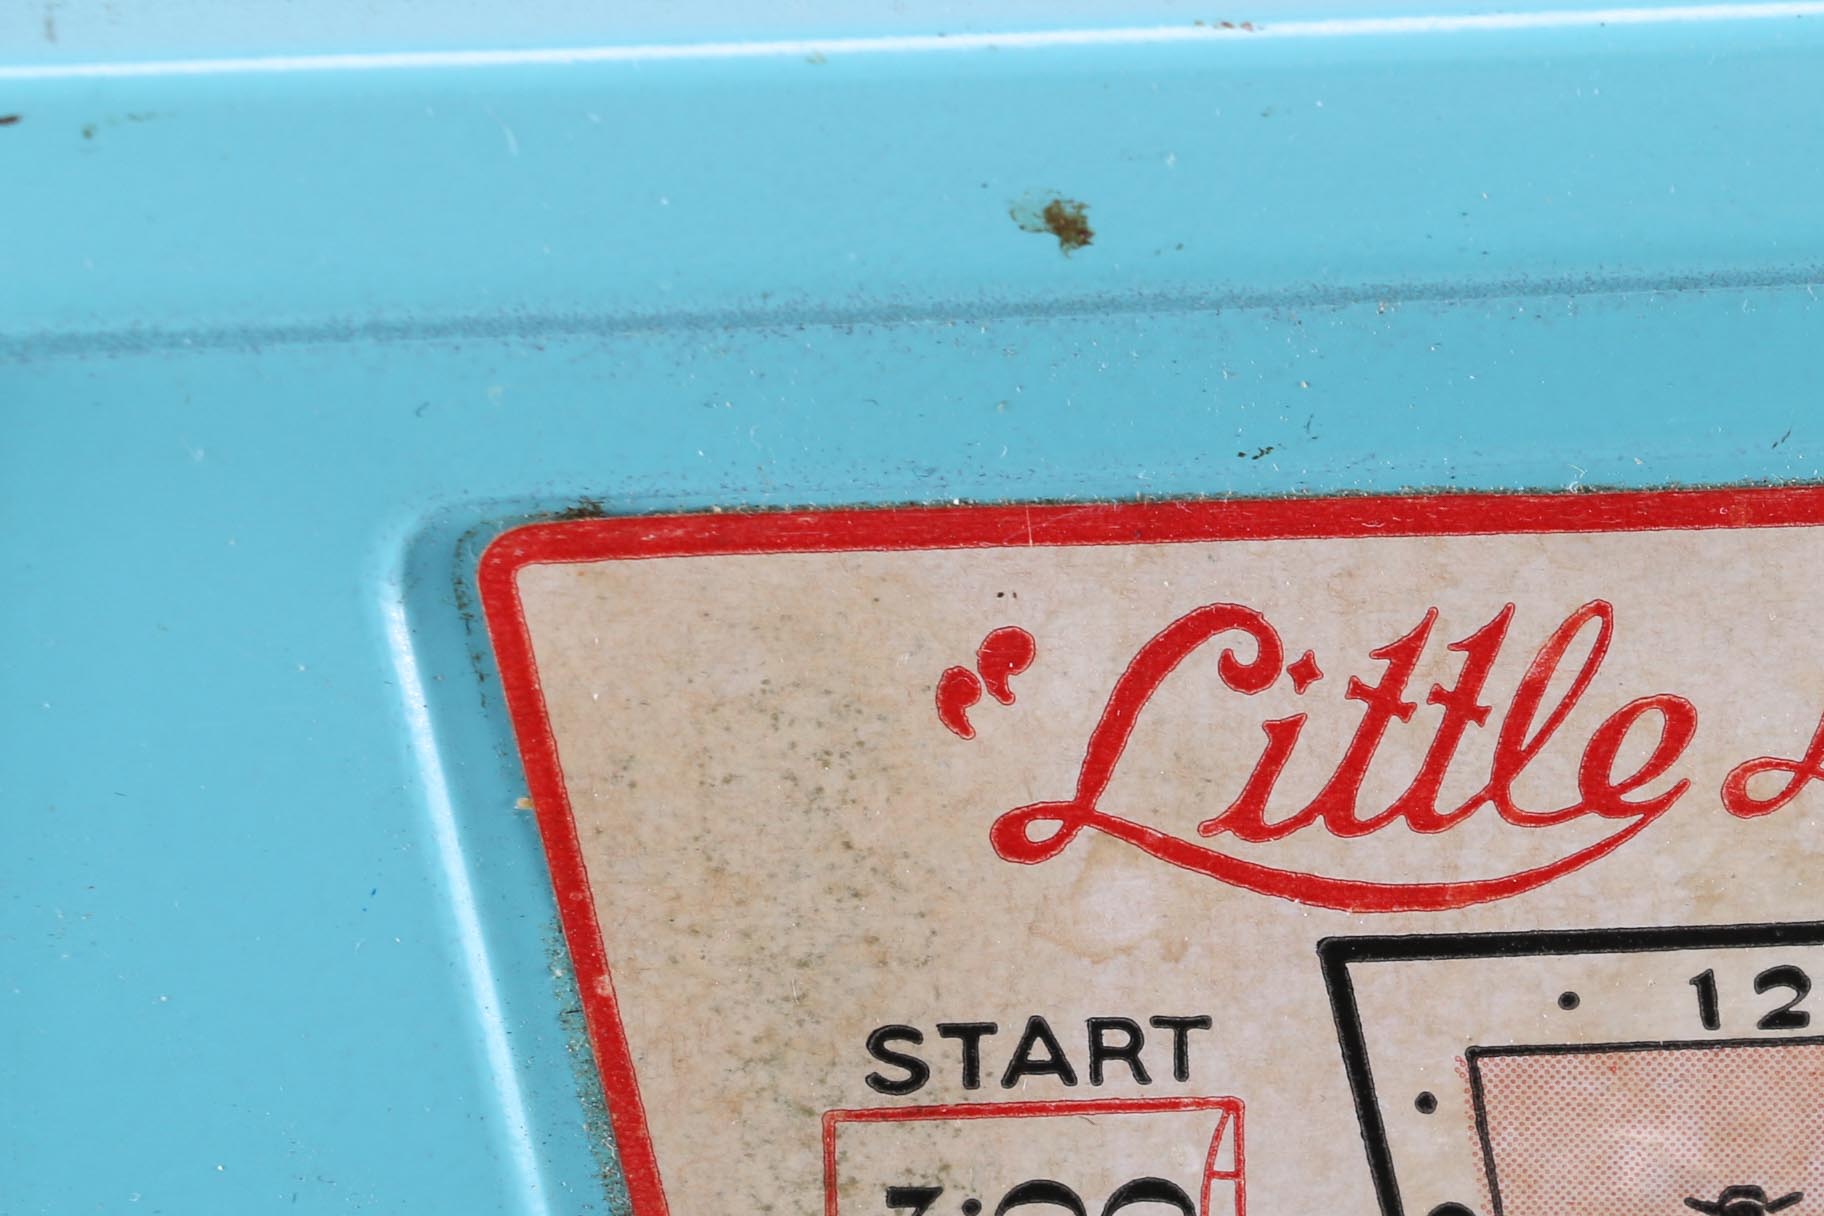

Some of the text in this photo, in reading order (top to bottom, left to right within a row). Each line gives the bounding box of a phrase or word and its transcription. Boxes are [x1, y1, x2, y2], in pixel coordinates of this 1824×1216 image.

[935, 599, 1698, 914] "Little
[1689, 964, 1812, 1031] 12
[864, 1014, 1213, 1097] START
